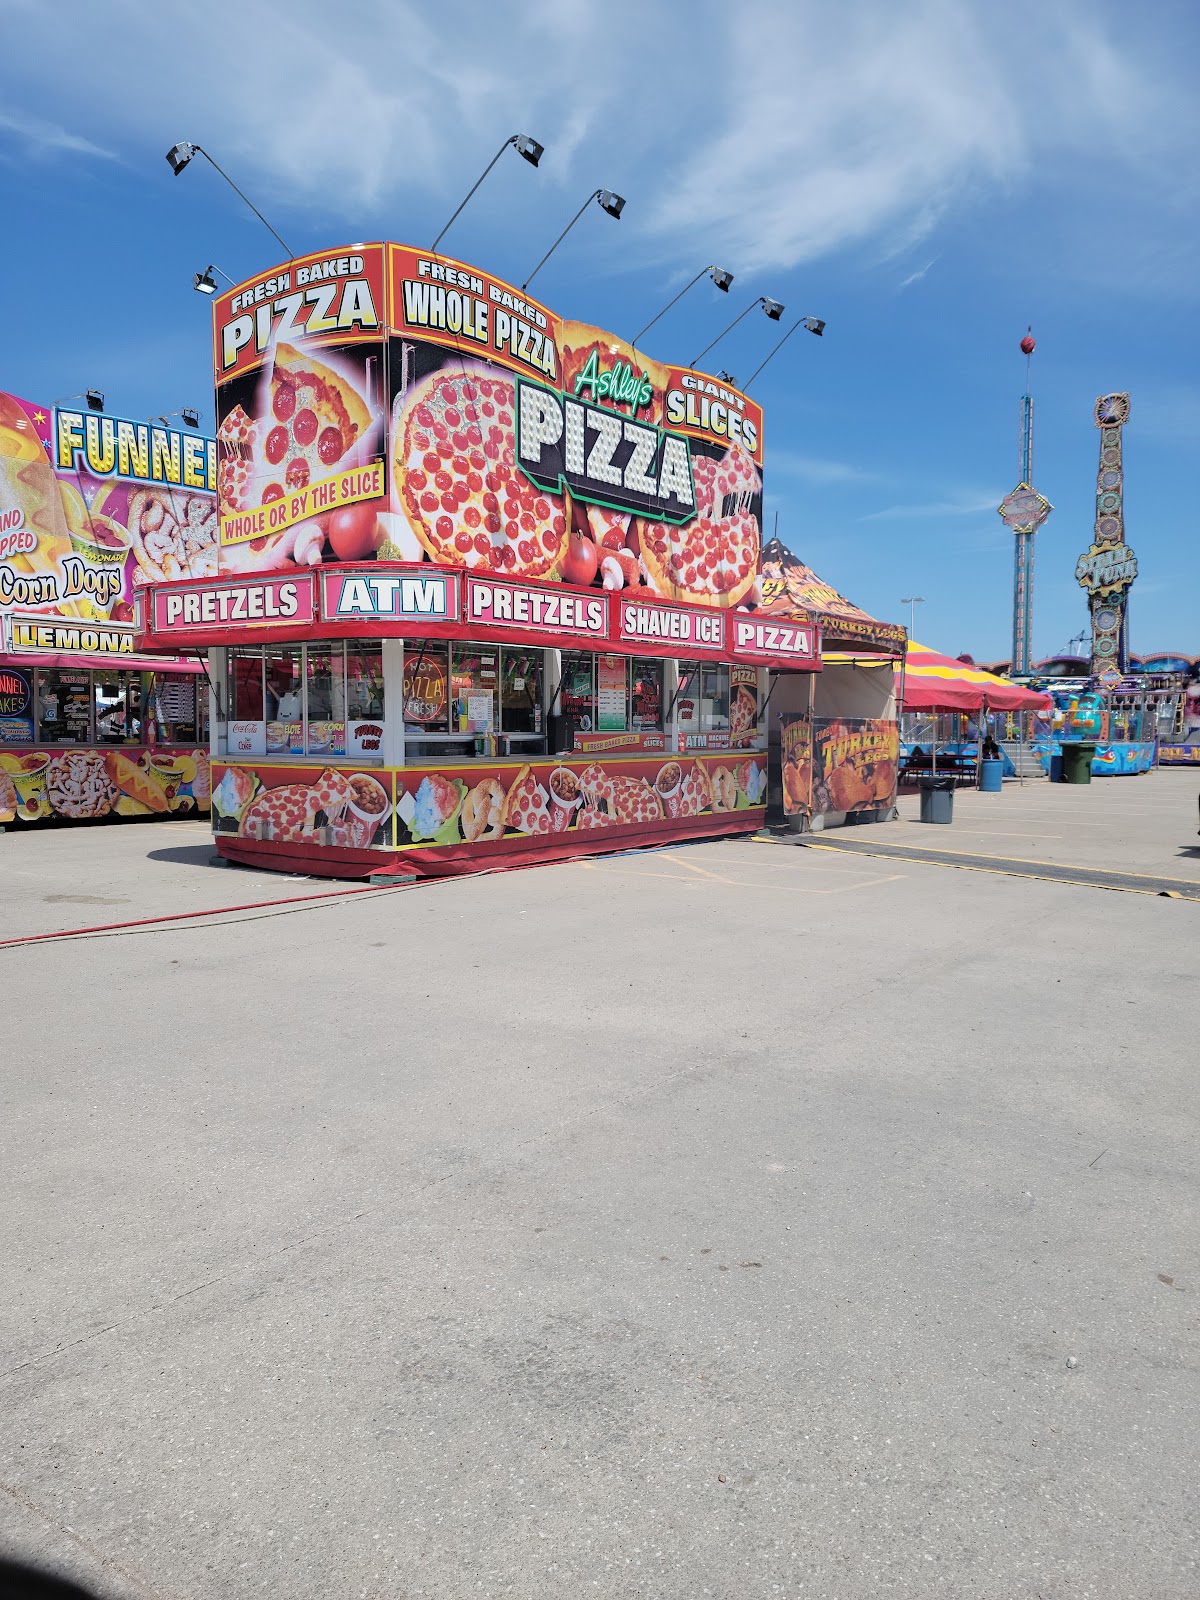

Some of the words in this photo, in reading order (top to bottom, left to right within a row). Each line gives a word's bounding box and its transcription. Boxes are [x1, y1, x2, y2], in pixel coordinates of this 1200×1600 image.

[231, 271, 291, 316] FRESH
[296, 255, 364, 287] BAKED
[417, 258, 484, 296] FRESH
[488, 282, 548, 330] BAKED
[221, 279, 379, 372] PIZZA
[402, 279, 489, 345] WHOLE
[494, 307, 557, 382] PIZZA
[575, 348, 652, 413] Ashley's
[681, 375, 746, 411] GIANT
[666, 390, 757, 454] SLICES
[519, 384, 694, 506] PIZZA
[224, 514, 265, 540] WHOLE
[269, 504, 287, 528] OR
[291, 492, 309, 518] BY
[311, 482, 336, 509] THE
[340, 470, 380, 498] SLICE
[79, 548, 125, 562] LEMONADE
[0, 566, 59, 605] Corn
[62, 557, 121, 606] Dogs
[337, 577, 447, 614] ATM
[166, 583, 299, 625] PRETZELS
[472, 584, 604, 631] PRETZELS
[624, 605, 691, 641] SHAVED
[695, 616, 721, 643] ICE
[738, 622, 809, 654] PIZZA
[822, 616, 875, 636] TURKEY
[874, 628, 907, 642] LEGS
[403, 675, 442, 699] PIZZA
[731, 670, 757, 685] PIZZA
[408, 701, 438, 715] FRESH
[284, 724, 301, 734] ELOTE
[323, 723, 344, 731] CORN
[354, 724, 383, 739] TURKEY
[362, 739, 380, 750] LEGS
[643, 740, 663, 748] SLICES
[686, 735, 707, 747] ATM
[329, 743, 344, 752] Cup
[822, 733, 890, 781] TURKEY
